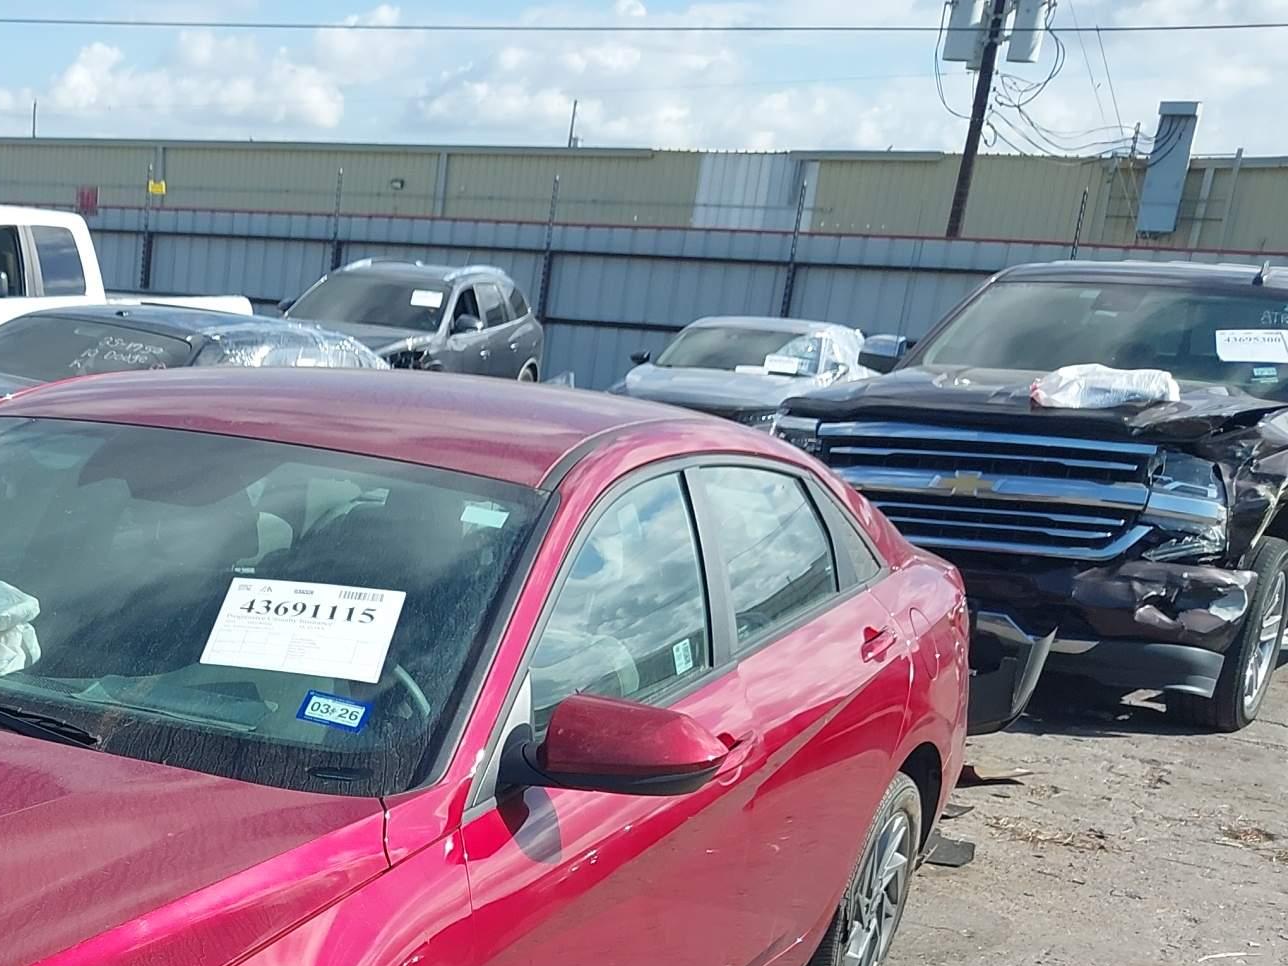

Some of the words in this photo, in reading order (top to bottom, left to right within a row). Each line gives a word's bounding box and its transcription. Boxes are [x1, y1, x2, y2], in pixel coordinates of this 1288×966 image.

[239, 598, 378, 624] 43691115
[310, 701, 331, 714] 03
[338, 707, 360, 721] 26
